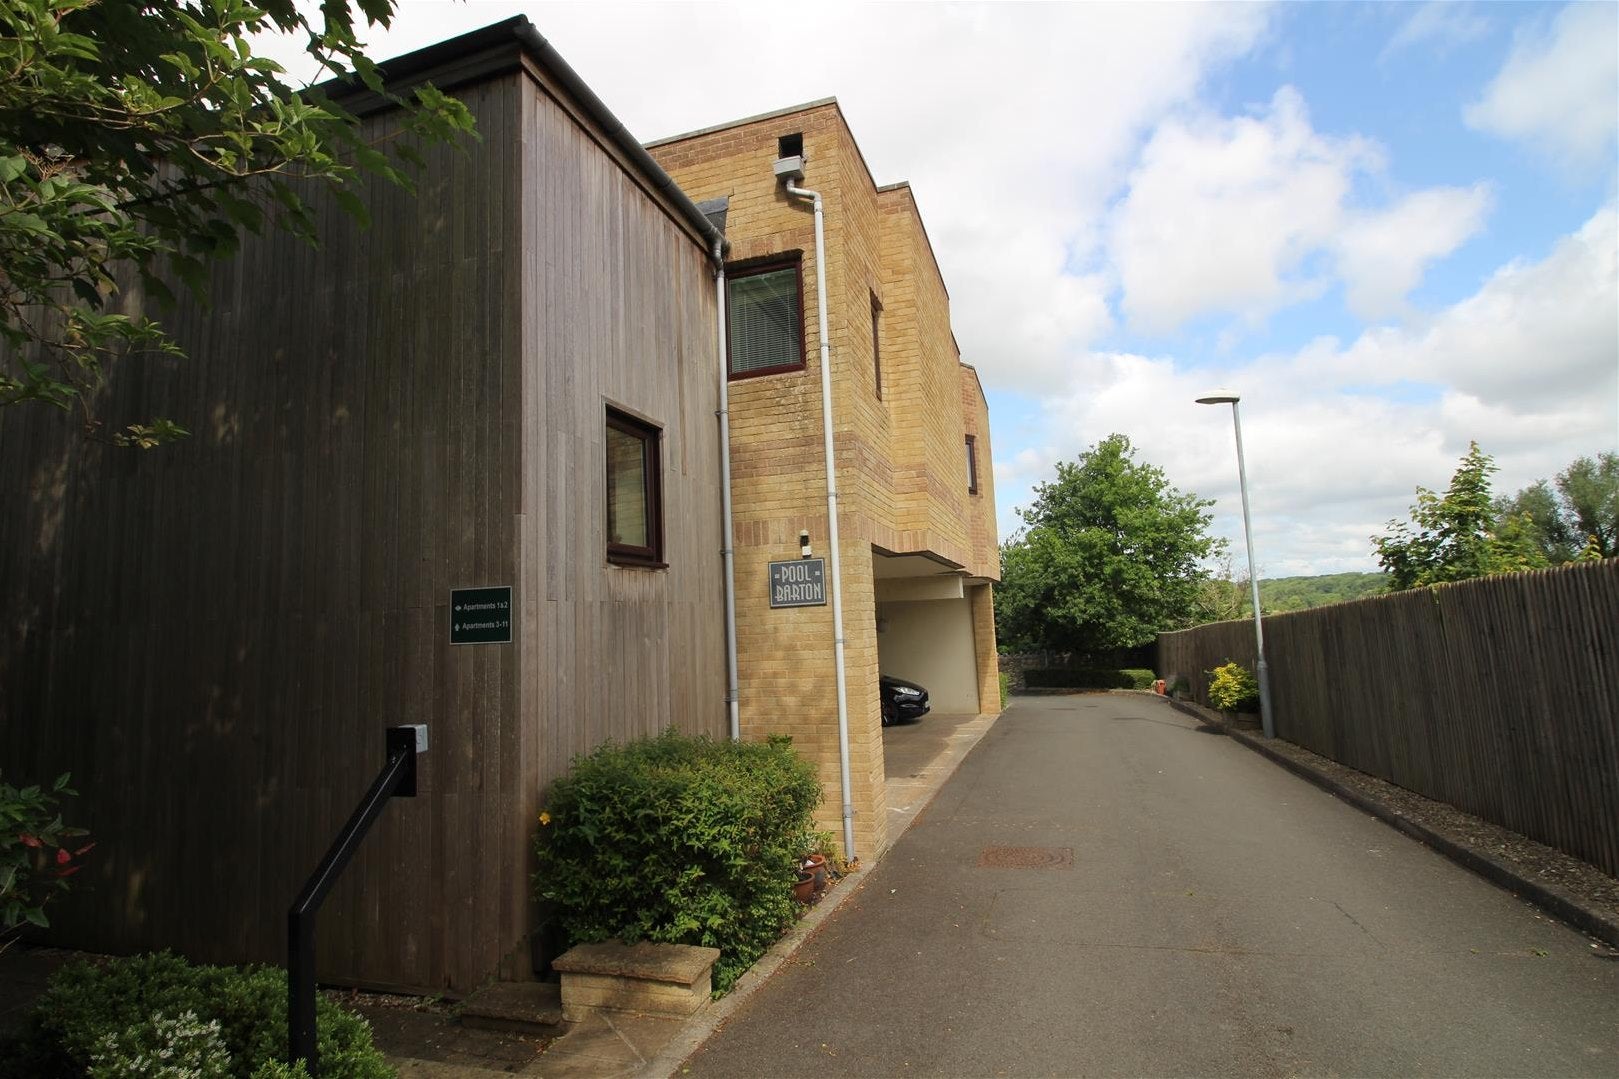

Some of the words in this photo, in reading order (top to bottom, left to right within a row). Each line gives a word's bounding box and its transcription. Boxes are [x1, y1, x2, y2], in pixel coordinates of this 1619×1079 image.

[781, 565, 812, 583] POOL
[775, 583, 822, 602] BARTON
[463, 603, 496, 612] Apartments
[462, 622, 495, 631] Apartments
